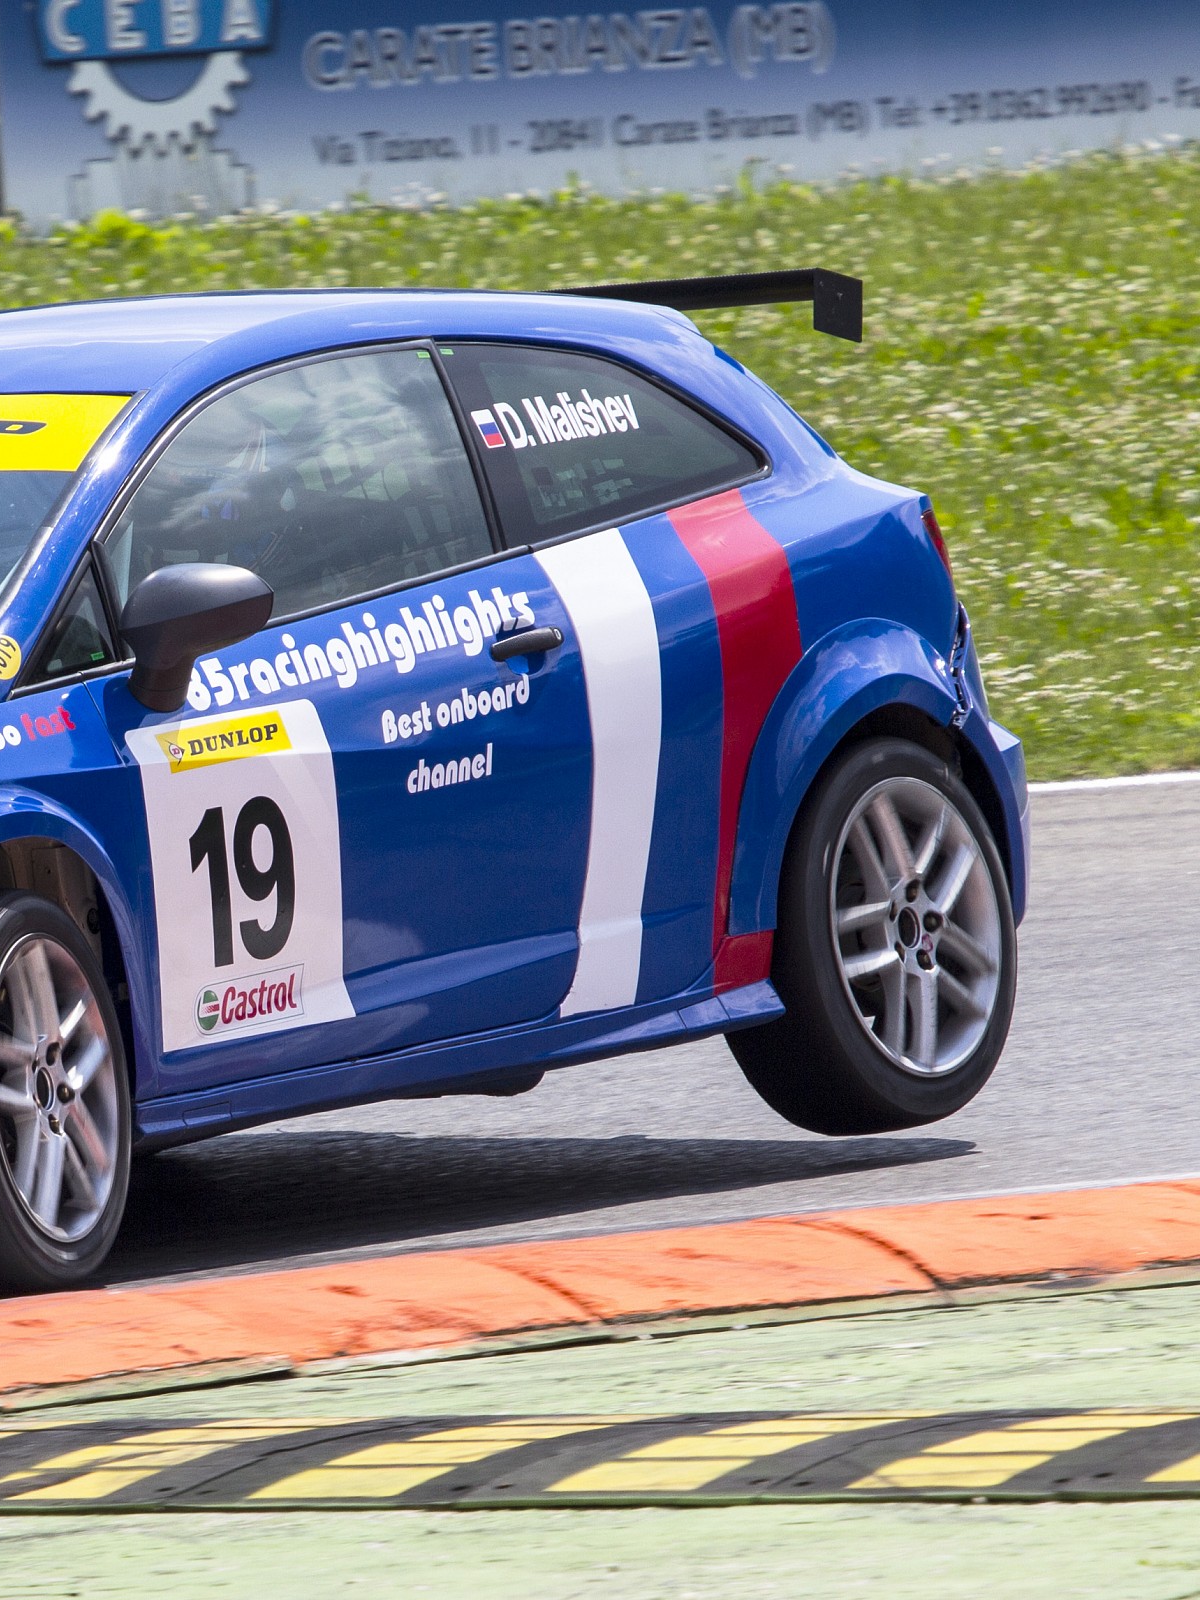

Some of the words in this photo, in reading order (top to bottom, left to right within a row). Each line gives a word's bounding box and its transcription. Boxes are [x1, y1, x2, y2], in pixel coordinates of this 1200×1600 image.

[304, 24, 498, 90] CARATE
[502, 12, 724, 78] BRIANZA
[729, 1, 836, 79] (MB)
[493, 402, 537, 449] D.
[521, 388, 640, 445] Malishev
[19, 705, 76, 741] fast
[381, 700, 433, 744] Best
[436, 672, 530, 727] onboard
[188, 723, 279, 757] DUNLOP
[406, 742, 494, 794] channel
[188, 796, 297, 968] 19
[221, 973, 298, 1025] Castrol
